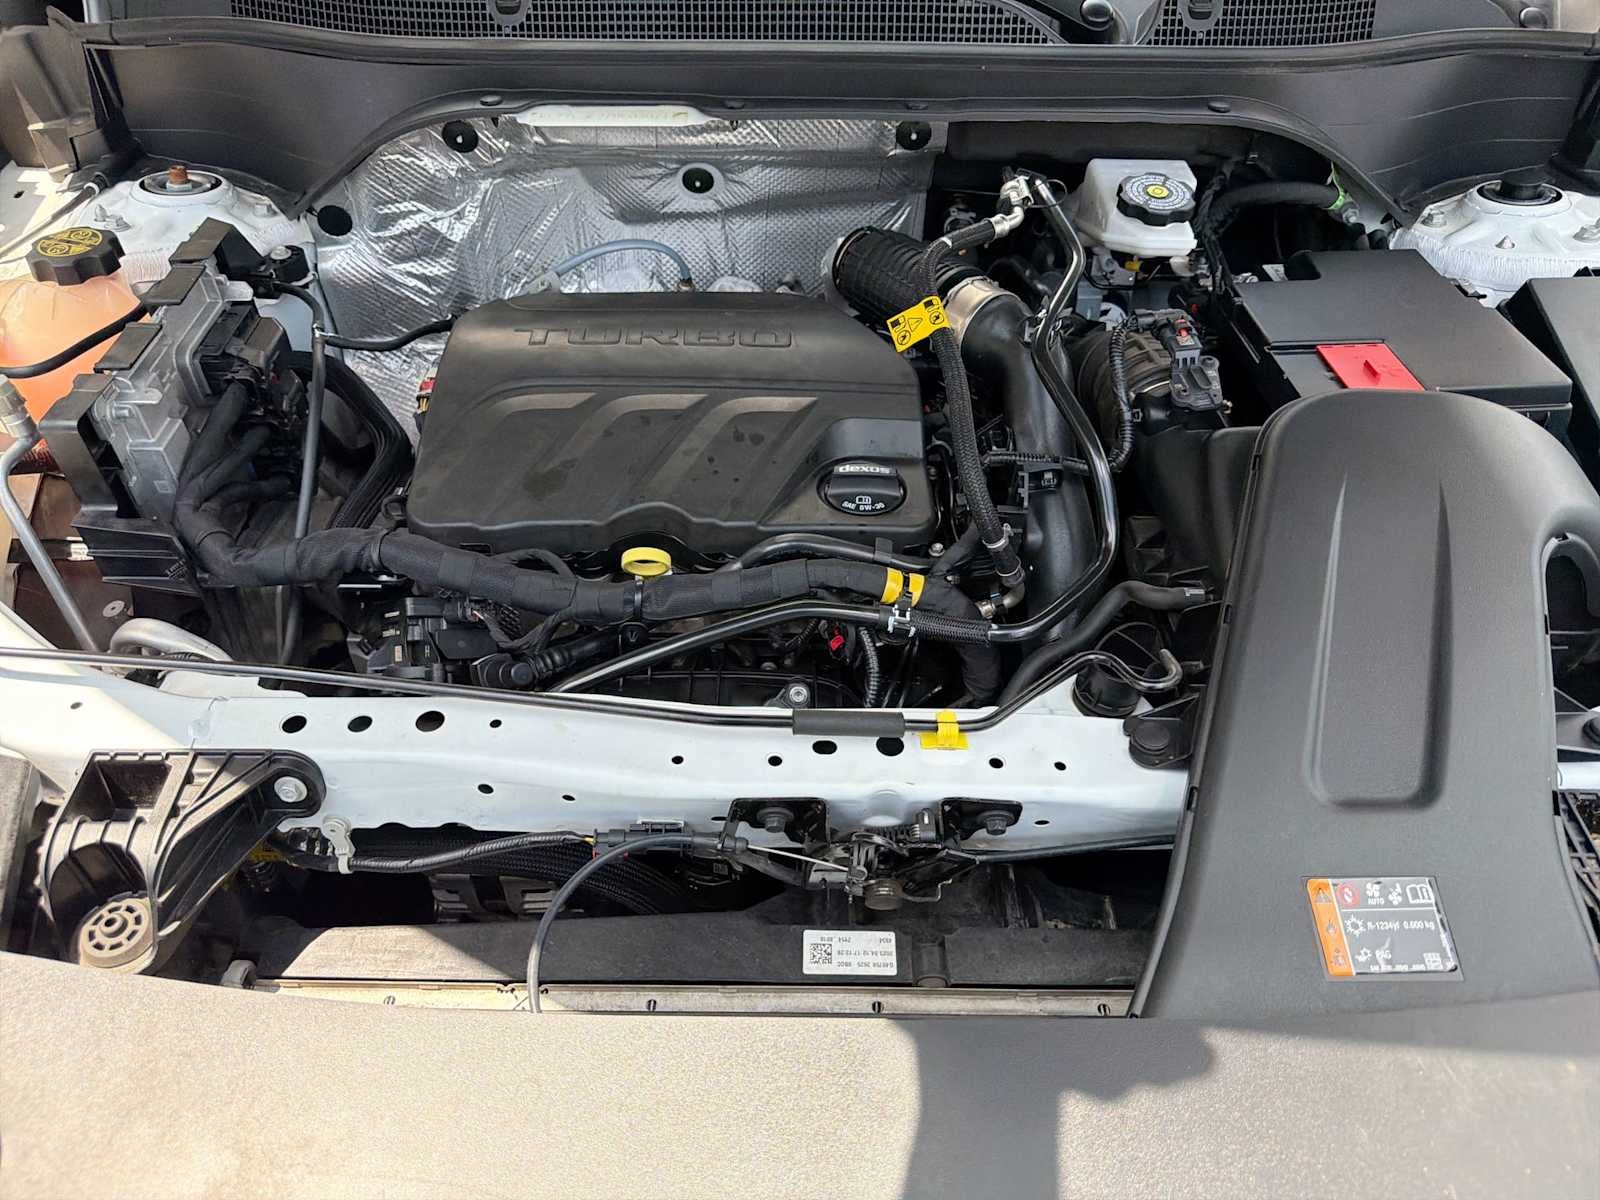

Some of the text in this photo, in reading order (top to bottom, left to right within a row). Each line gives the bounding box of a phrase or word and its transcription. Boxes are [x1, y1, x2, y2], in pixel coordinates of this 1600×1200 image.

[514, 327, 792, 348] TURBO
[838, 464, 890, 474] dexos
[841, 501, 857, 510] SAE
[1367, 897, 1385, 905] AUTO
